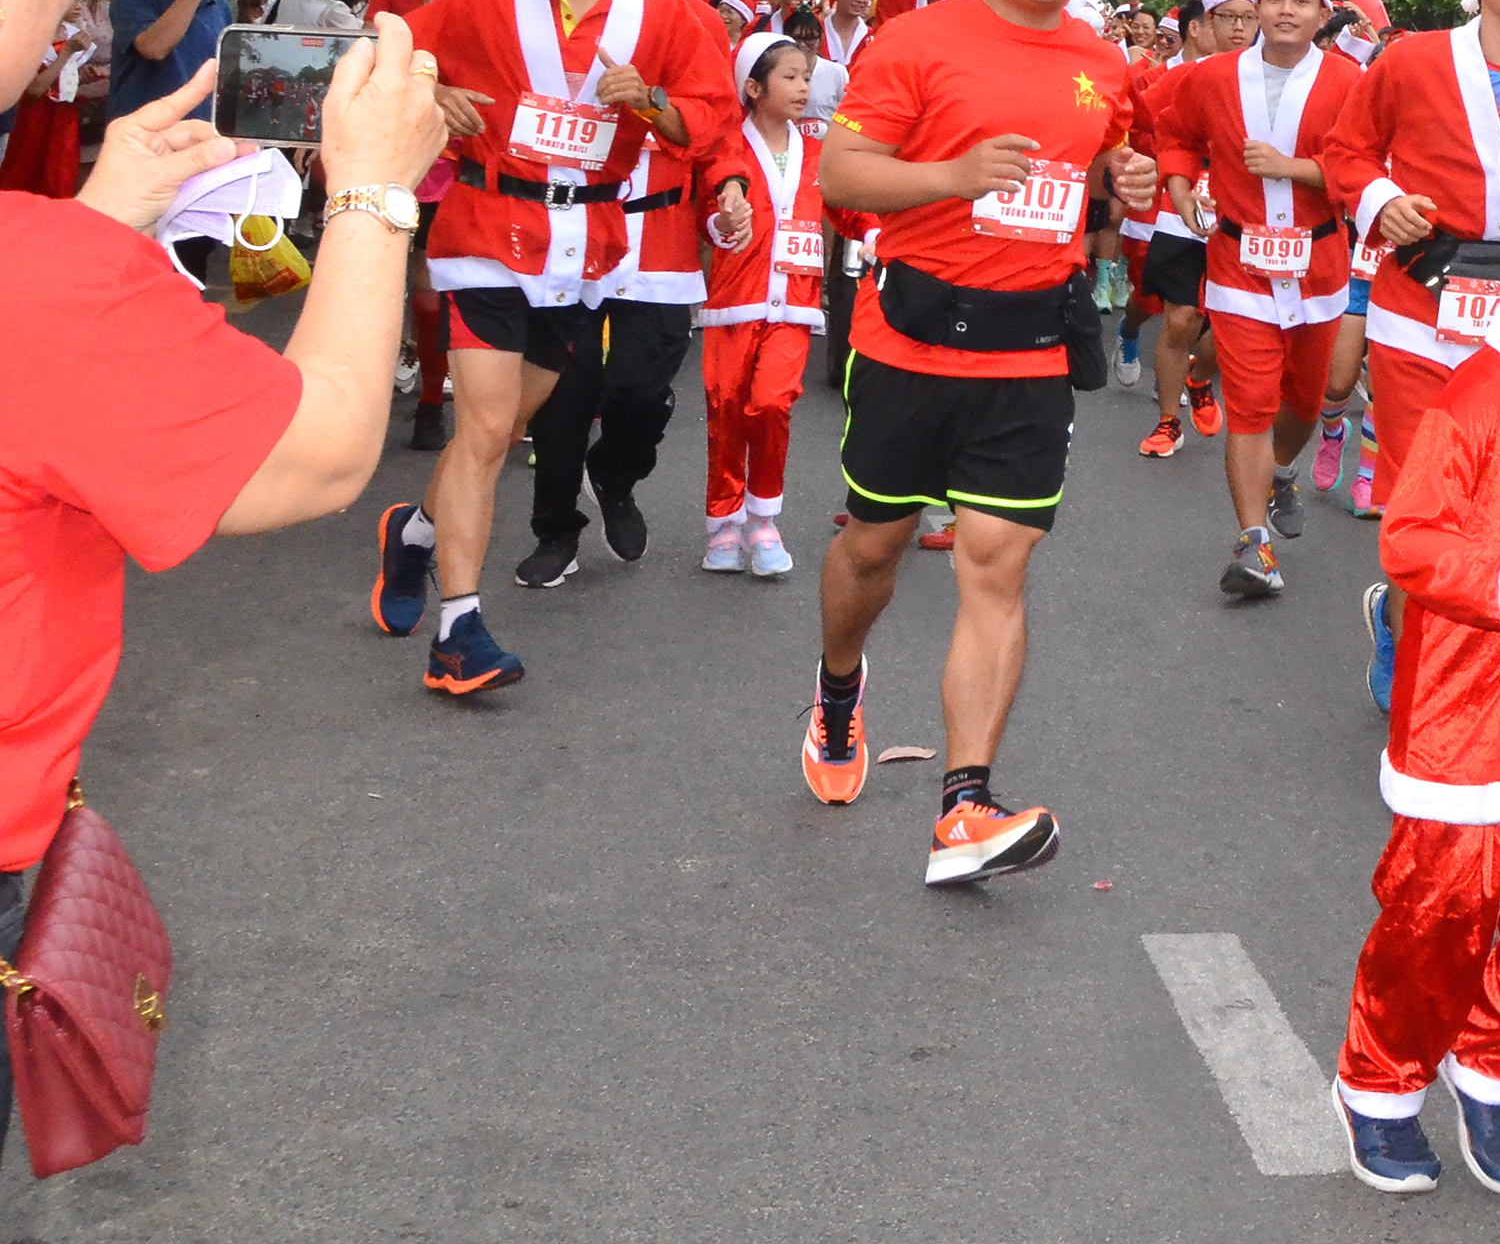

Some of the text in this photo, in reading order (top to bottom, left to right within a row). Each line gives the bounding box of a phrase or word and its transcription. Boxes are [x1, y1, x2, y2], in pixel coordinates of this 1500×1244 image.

[536, 112, 598, 144] 1119
[787, 236, 823, 257] 544
[1248, 237, 1304, 258] 5090
